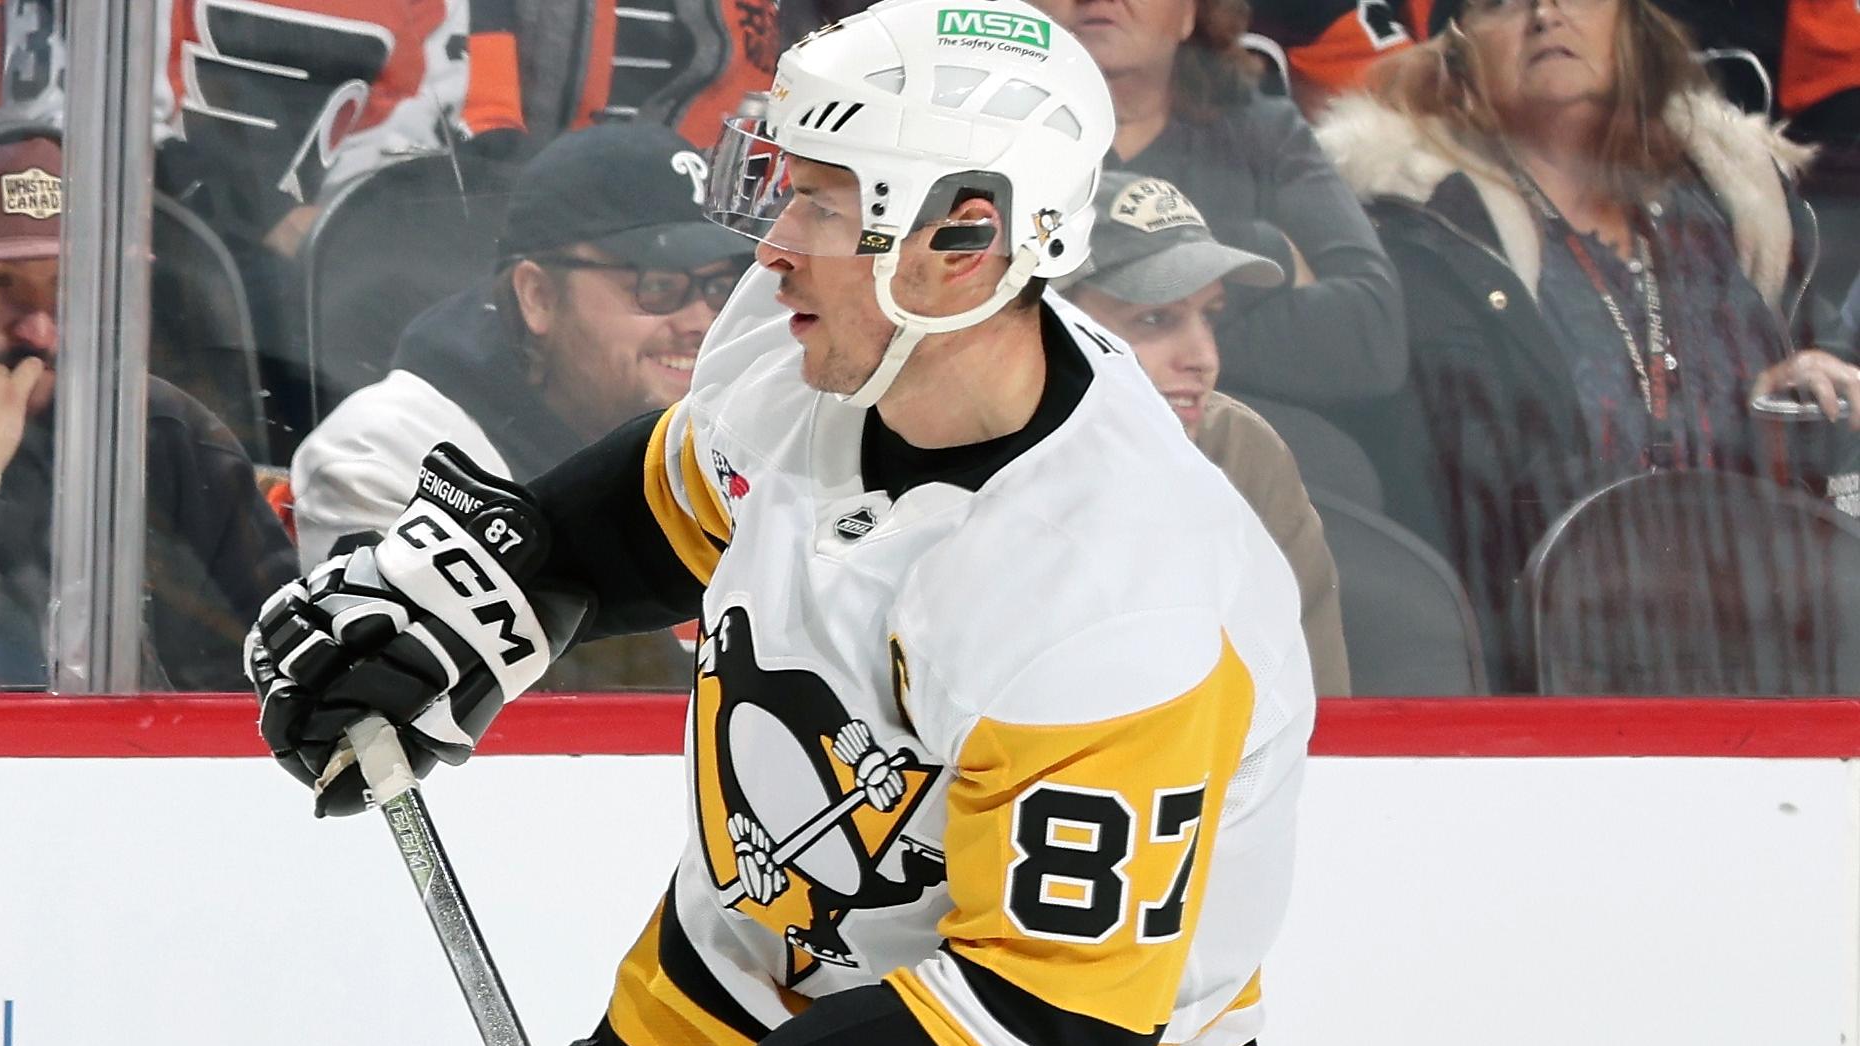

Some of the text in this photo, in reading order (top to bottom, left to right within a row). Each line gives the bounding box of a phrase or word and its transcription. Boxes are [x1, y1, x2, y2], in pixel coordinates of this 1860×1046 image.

[941, 11, 1046, 46] MSA
[938, 37, 1049, 63] The Safety Company
[5, 178, 61, 195] WHISTL
[7, 193, 60, 210] CANAD
[484, 517, 524, 555] 87
[396, 514, 536, 667] CCM
[1003, 781, 1207, 944] 87
